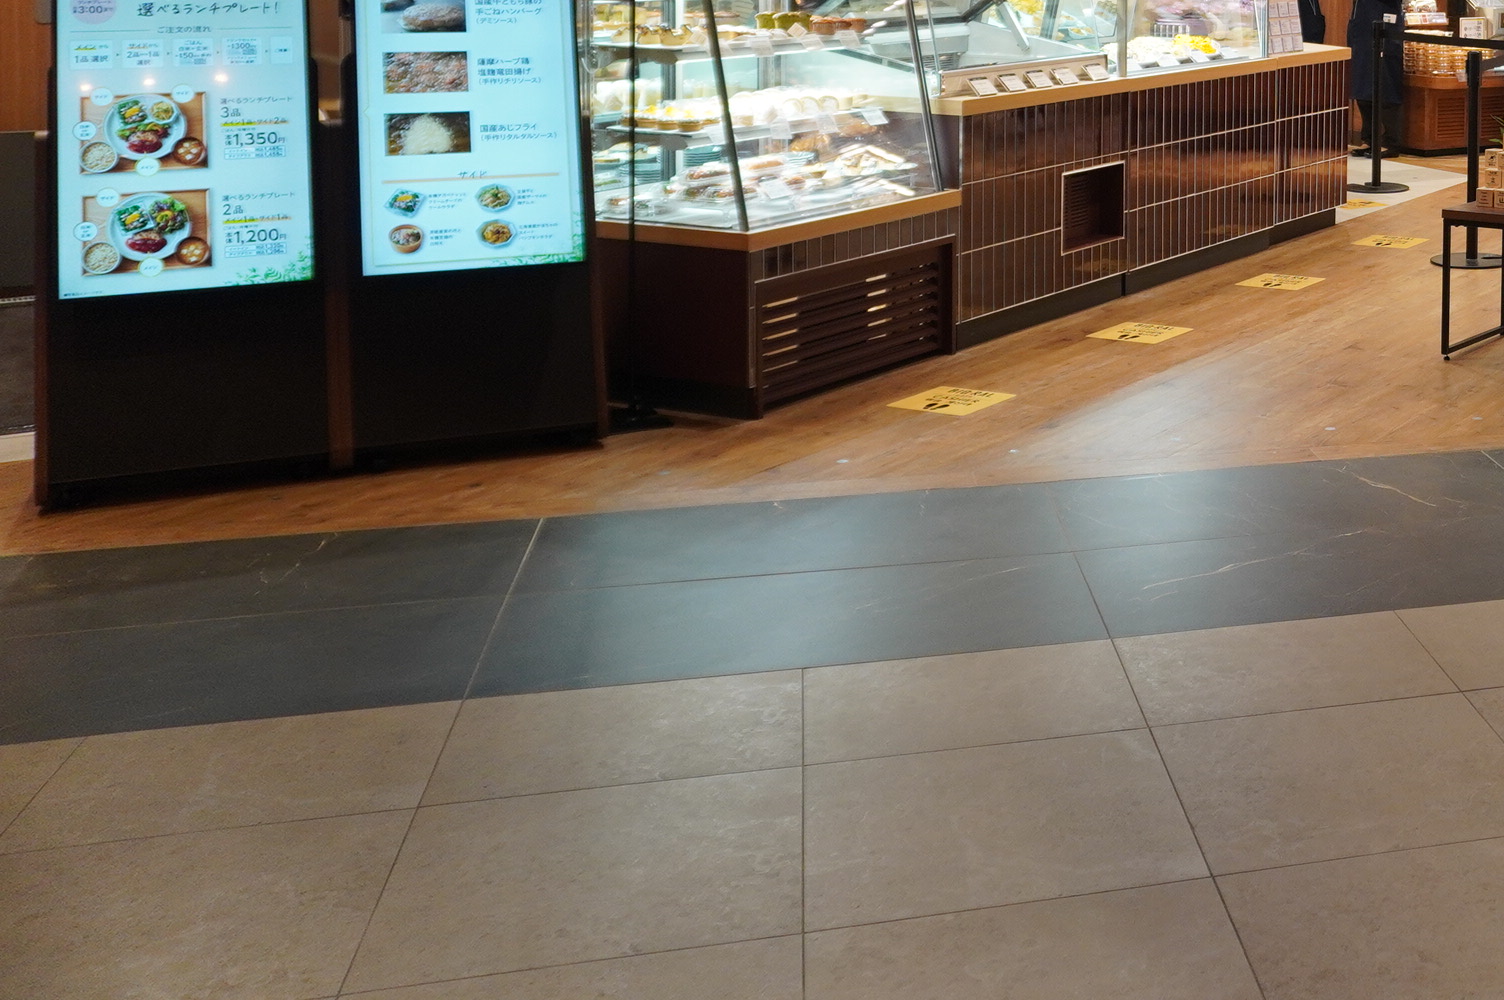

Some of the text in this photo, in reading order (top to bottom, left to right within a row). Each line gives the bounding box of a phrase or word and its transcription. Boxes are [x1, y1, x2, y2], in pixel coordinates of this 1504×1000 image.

[156, 25, 212, 34] ご注文の流れ
[220, 106, 241, 118] 3品
[222, 203, 244, 215] 2品
